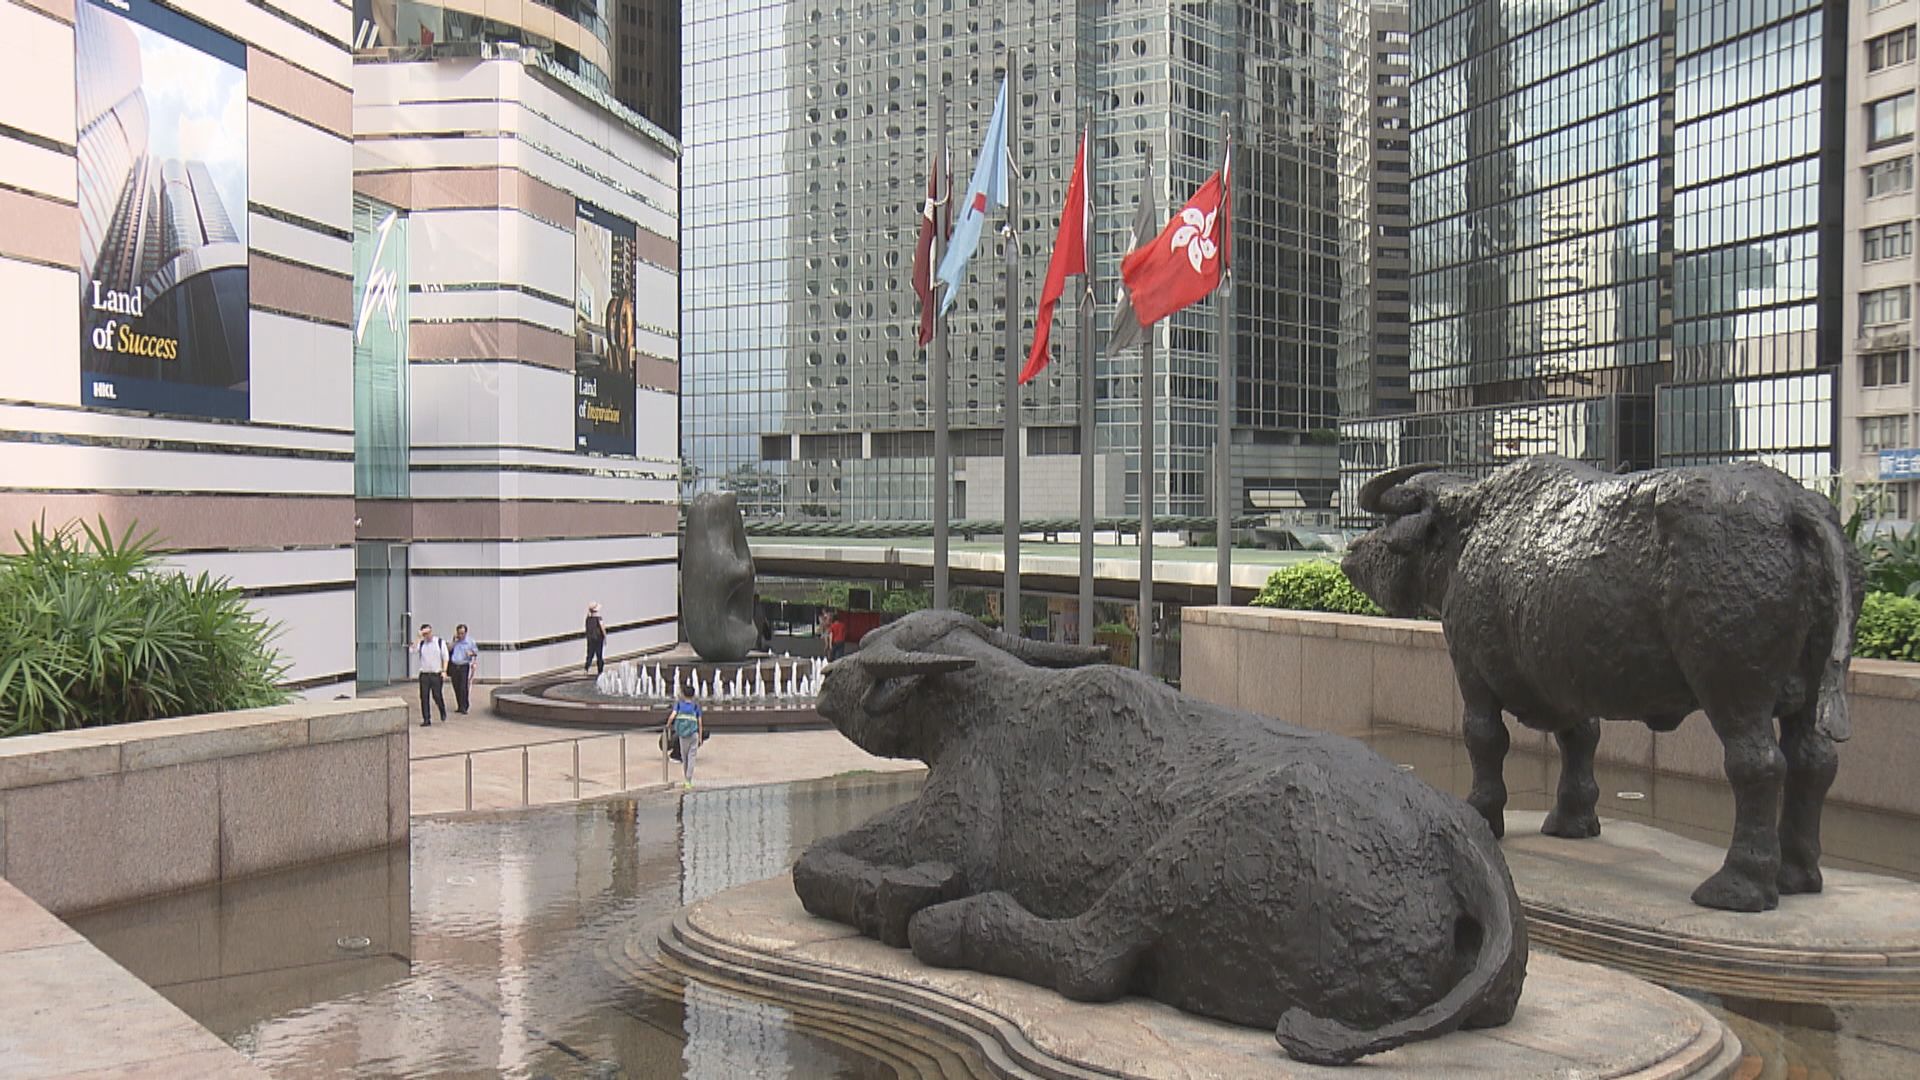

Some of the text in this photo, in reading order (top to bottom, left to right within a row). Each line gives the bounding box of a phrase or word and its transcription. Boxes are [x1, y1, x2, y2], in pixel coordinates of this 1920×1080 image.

[92, 280, 143, 317] Land
[92, 320, 177, 359] of Success
[93, 382, 117, 399] HKL
[579, 376, 597, 397] Land
[579, 400, 620, 425] of Inspiration
